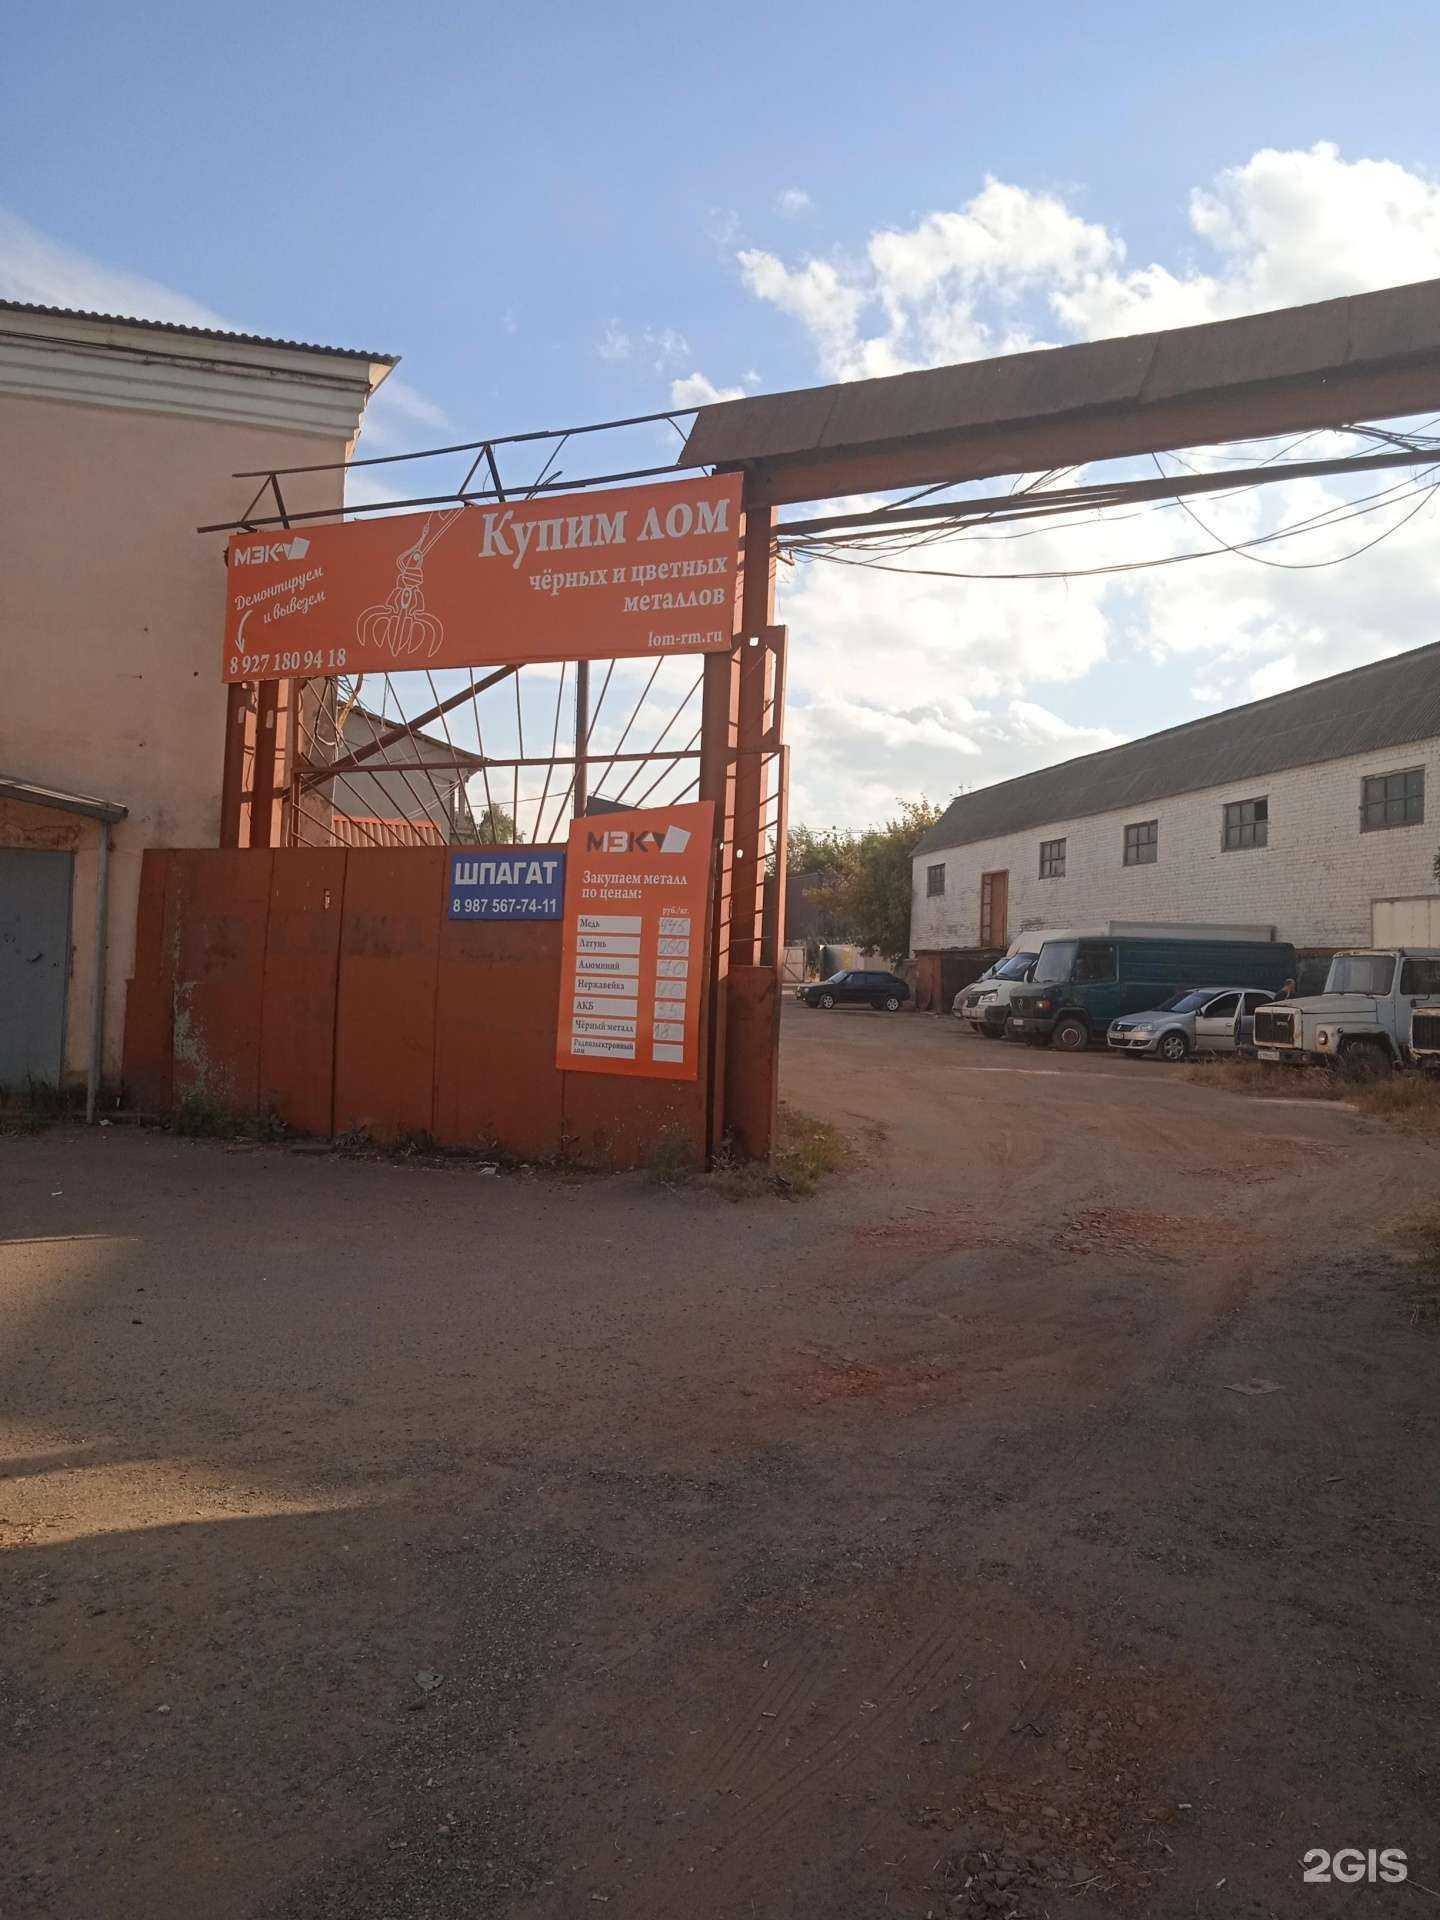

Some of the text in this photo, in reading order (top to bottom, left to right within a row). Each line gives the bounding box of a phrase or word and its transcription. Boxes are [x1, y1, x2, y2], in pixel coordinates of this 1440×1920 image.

[479, 509, 628, 570] Купим
[529, 556, 728, 596] чёрных и цветных
[234, 566, 325, 611] Демонтируем
[623, 587, 726, 613] металлов
[263, 591, 327, 624] и вывезем
[648, 630, 722, 647] lom-rm.ru
[230, 649, 347, 674] 8 927 180 94 18
[455, 861, 558, 885] ШПАГАТ
[582, 870, 688, 889] Закупаем металл
[582, 887, 642, 899] по ценам:
[453, 899, 557, 912] 8 987 567-74-11
[579, 918, 600, 928] Медь
